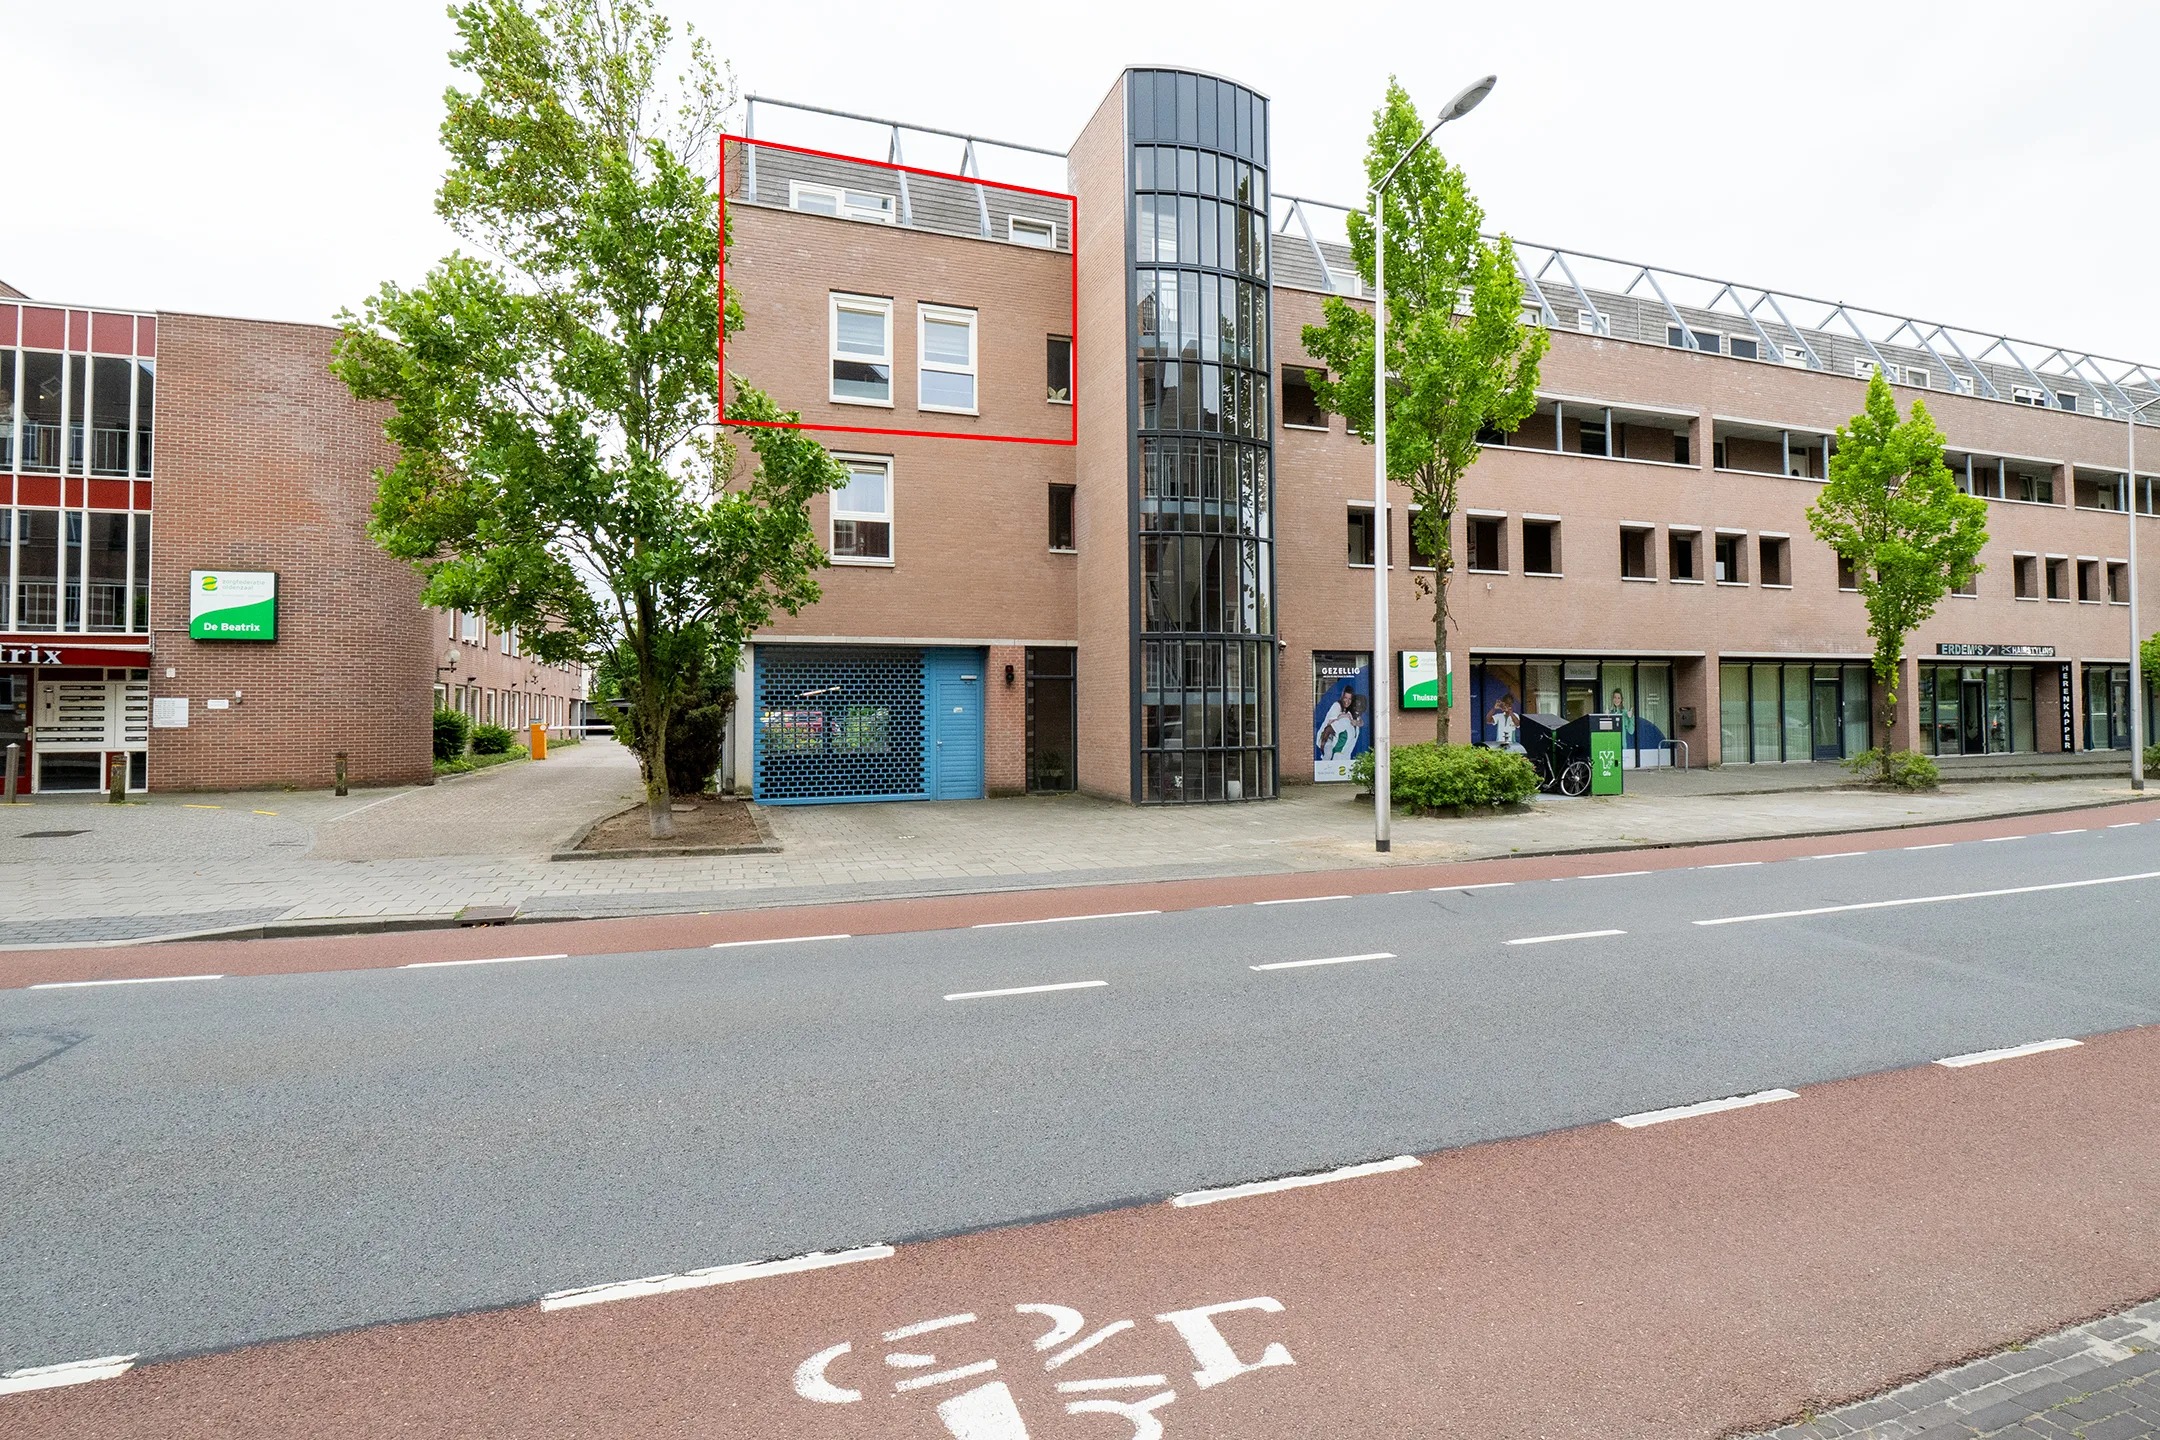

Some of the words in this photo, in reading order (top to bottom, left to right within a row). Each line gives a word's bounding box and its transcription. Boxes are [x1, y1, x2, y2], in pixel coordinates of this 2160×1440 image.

[203, 622, 218, 631] De
[221, 623, 260, 632] Beatrix
[1941, 644, 1984, 655] ERDEM'S
[1322, 667, 1360, 675] GEZELLIG
[1413, 694, 1437, 702] Thuiszo
[2062, 665, 2071, 749] HERENKAPPER
